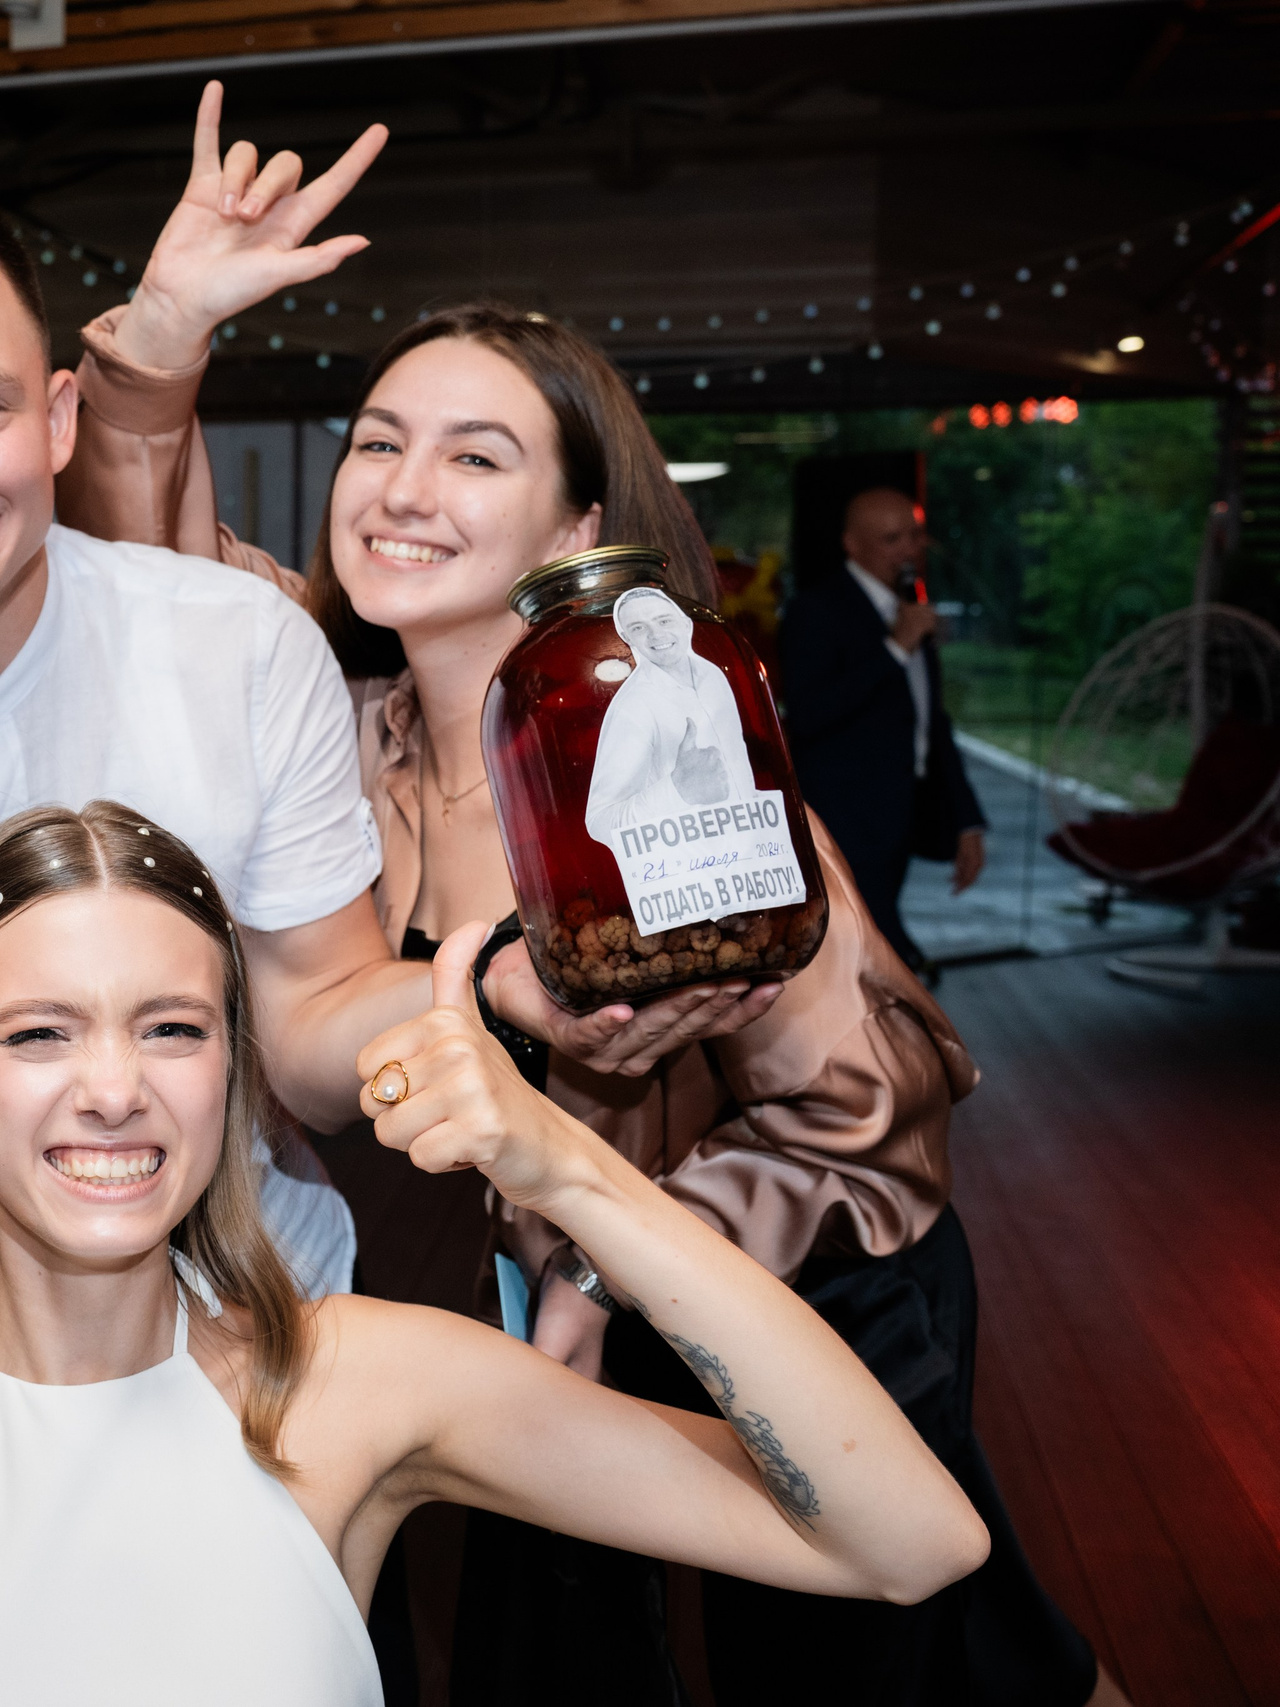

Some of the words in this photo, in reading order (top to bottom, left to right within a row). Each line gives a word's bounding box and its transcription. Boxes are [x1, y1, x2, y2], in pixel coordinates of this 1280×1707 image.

[620, 799, 780, 858] ПРОВЕРЕНО
[638, 882, 715, 926] ОТДАТЬ
[714, 878, 732, 906] В
[731, 865, 801, 902] РАБОТУ!
